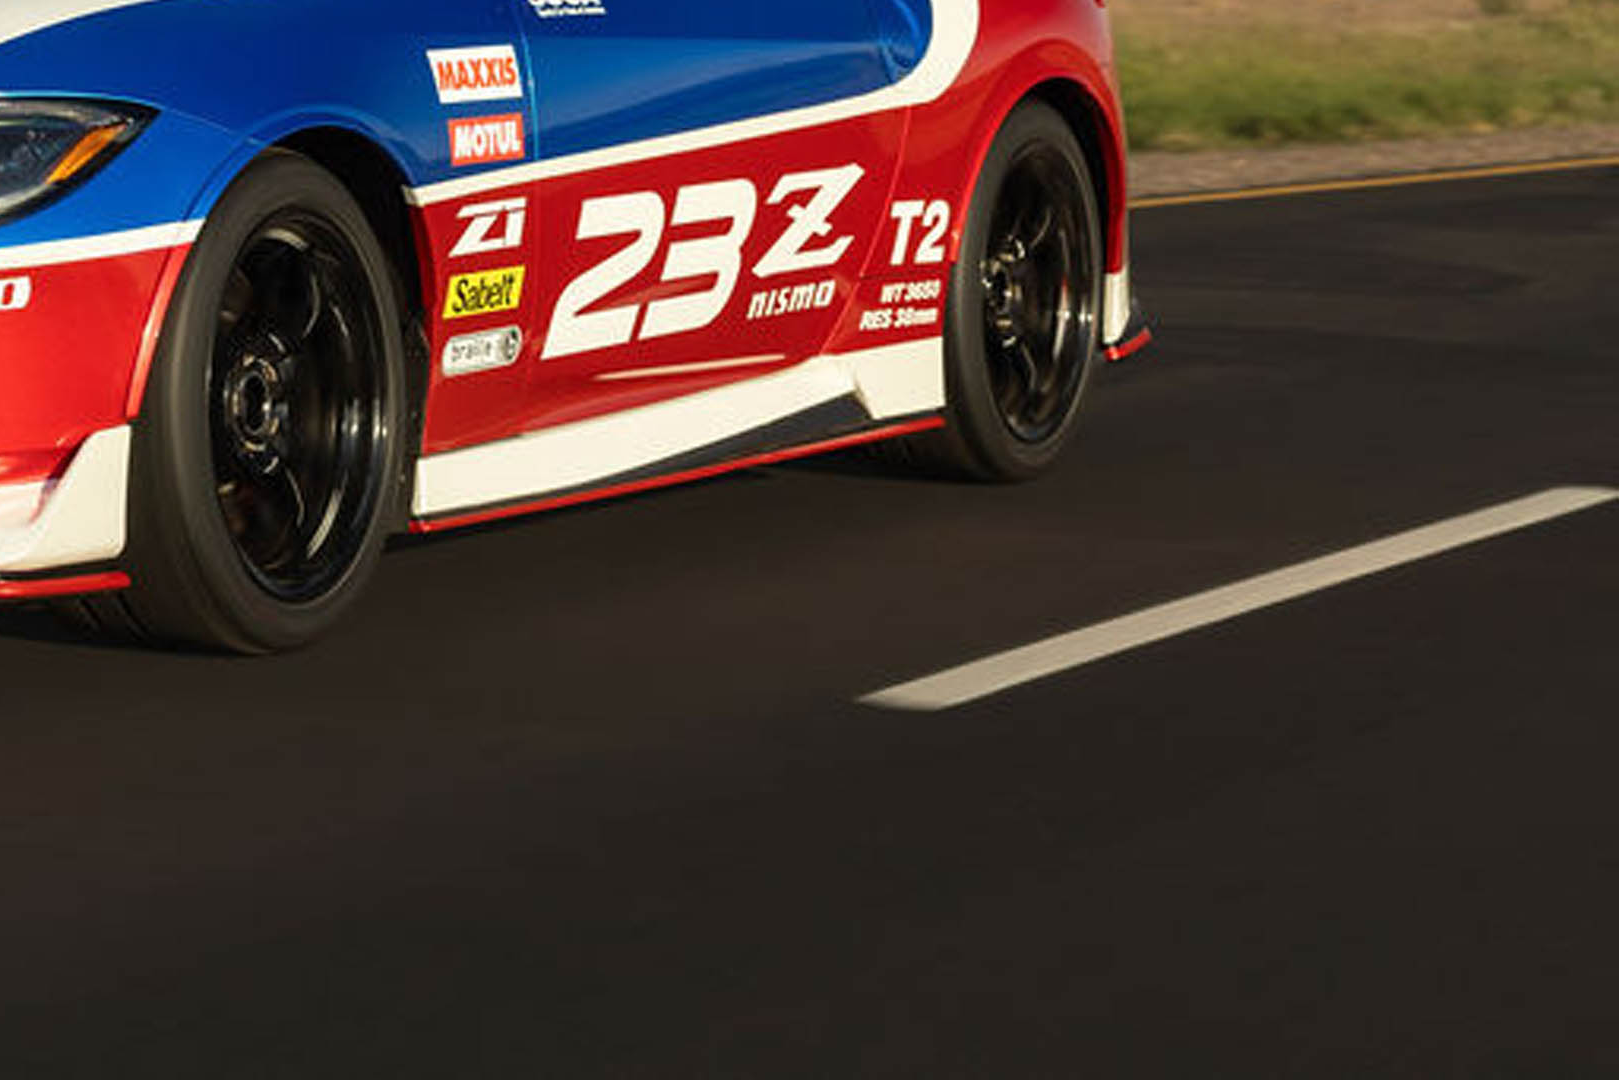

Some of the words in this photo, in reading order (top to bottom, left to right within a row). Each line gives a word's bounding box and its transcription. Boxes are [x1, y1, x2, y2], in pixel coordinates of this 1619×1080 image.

[436, 57, 517, 91] MAXXIS
[454, 120, 521, 159] MOTUL
[889, 199, 951, 266] T2
[540, 178, 757, 360] 23
[452, 273, 515, 312] Sabelt
